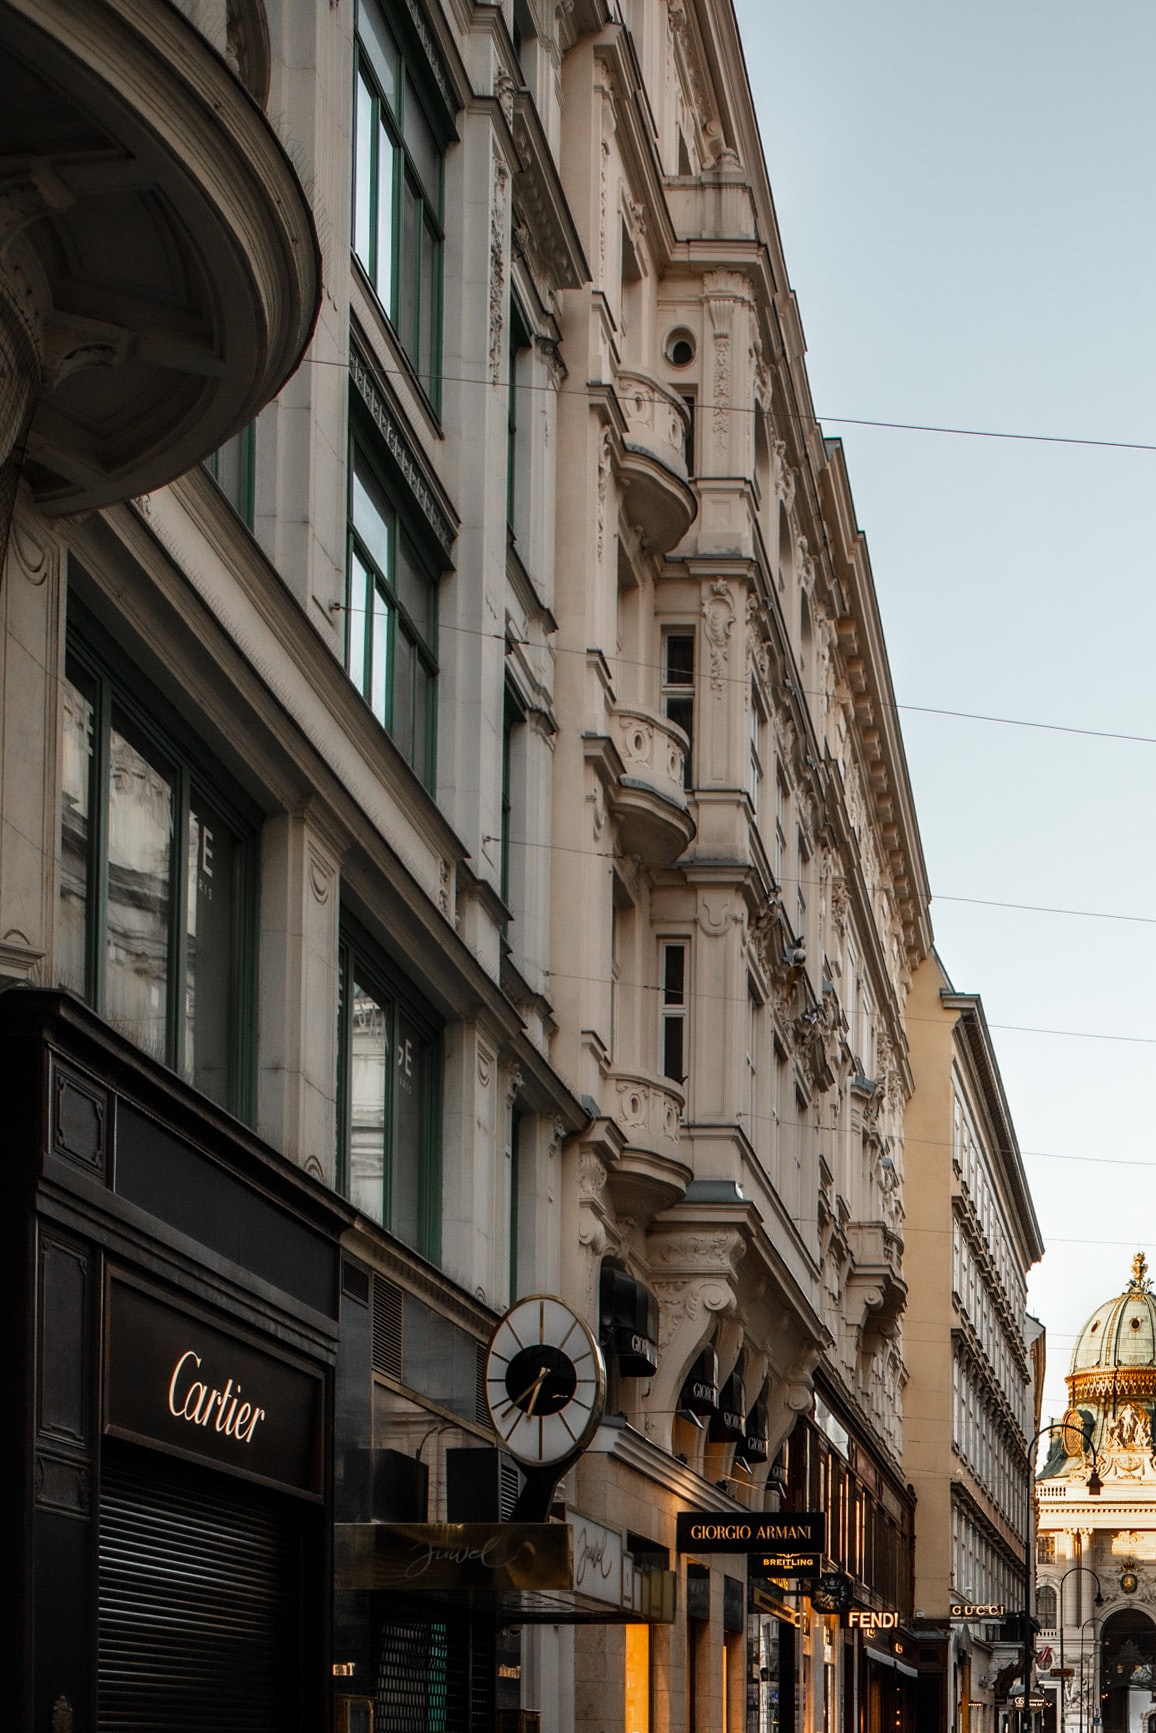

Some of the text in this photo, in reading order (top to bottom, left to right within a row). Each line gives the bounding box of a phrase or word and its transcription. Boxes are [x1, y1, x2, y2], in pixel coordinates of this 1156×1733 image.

[168, 1350, 266, 1443] Cartier
[690, 1524, 812, 1540] GIORGIO ARMANI
[762, 1558, 814, 1567] BREITLING
[951, 1605, 1005, 1617] GUCCI
[848, 1611, 899, 1629] FENDI
